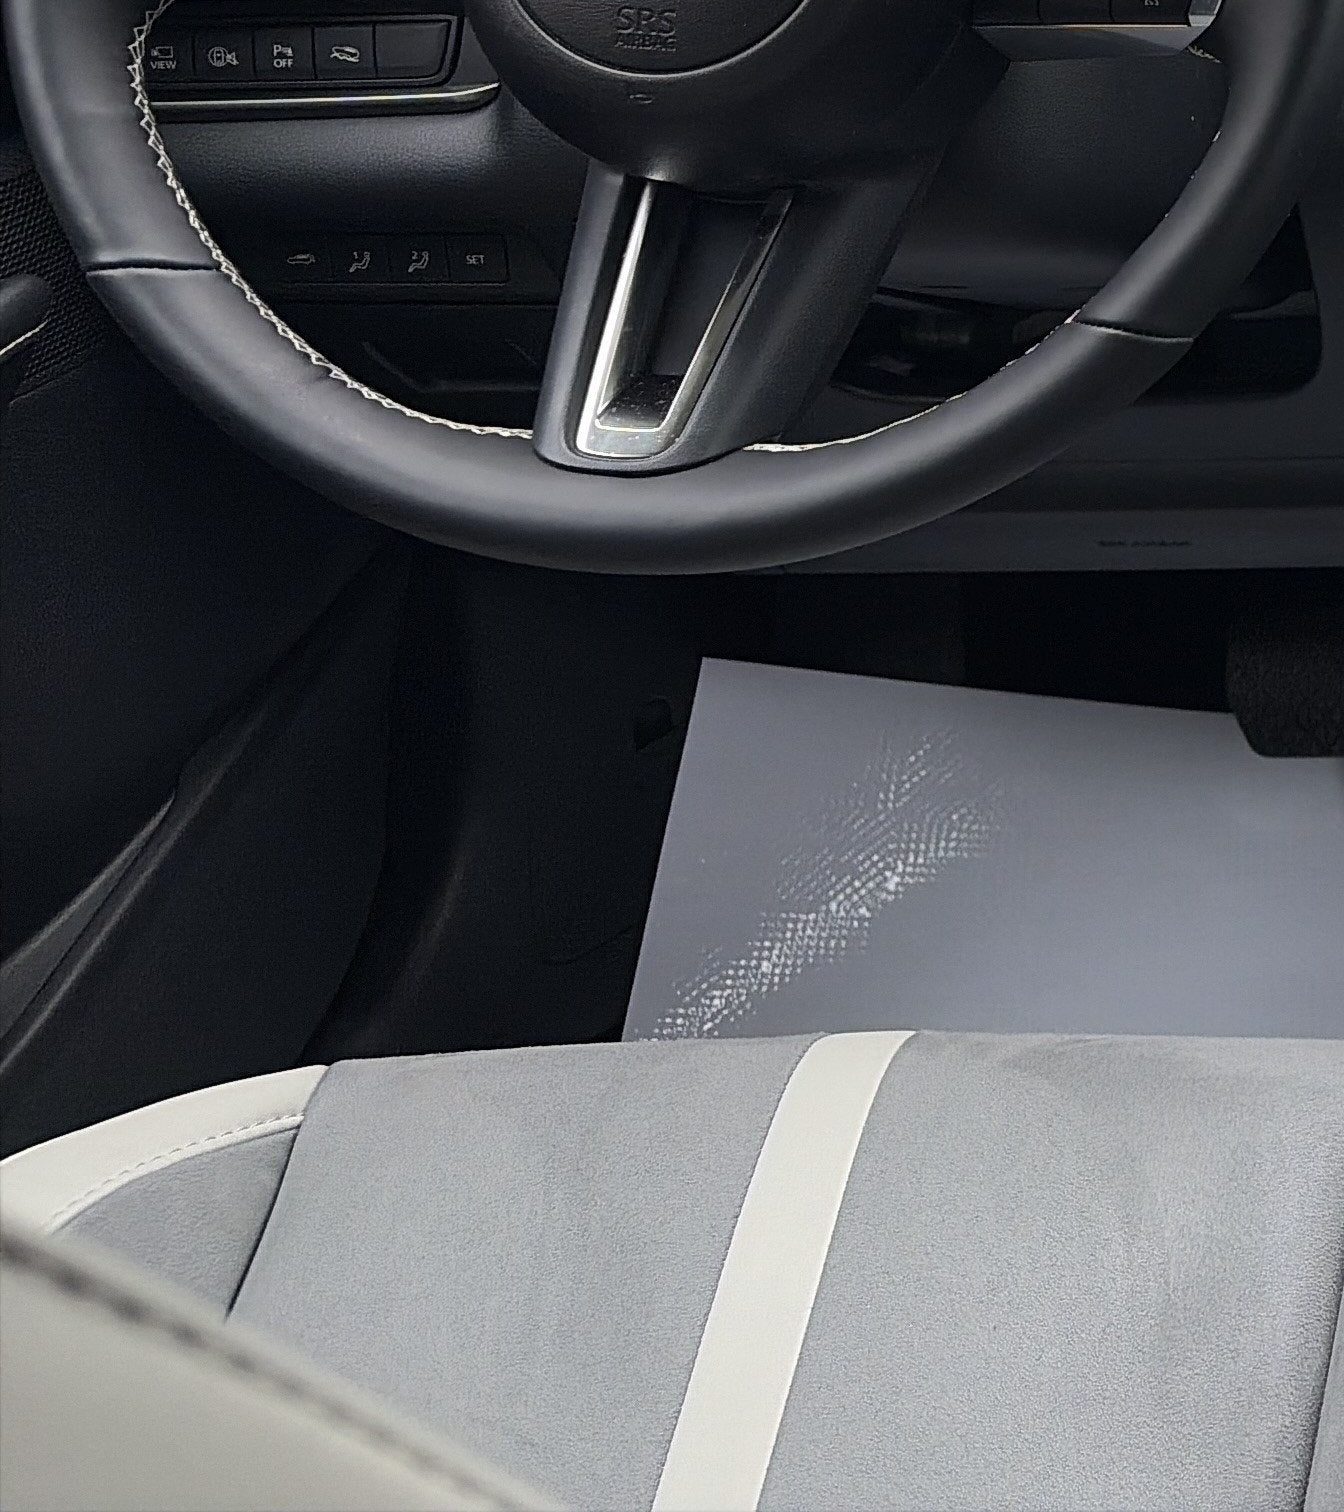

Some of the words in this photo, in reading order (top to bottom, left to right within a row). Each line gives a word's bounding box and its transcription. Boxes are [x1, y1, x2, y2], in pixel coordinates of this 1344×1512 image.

[615, 6, 677, 36] SRS
[150, 60, 177, 70] VIEW
[273, 59, 293, 69] OFF
[466, 254, 485, 265] SET
